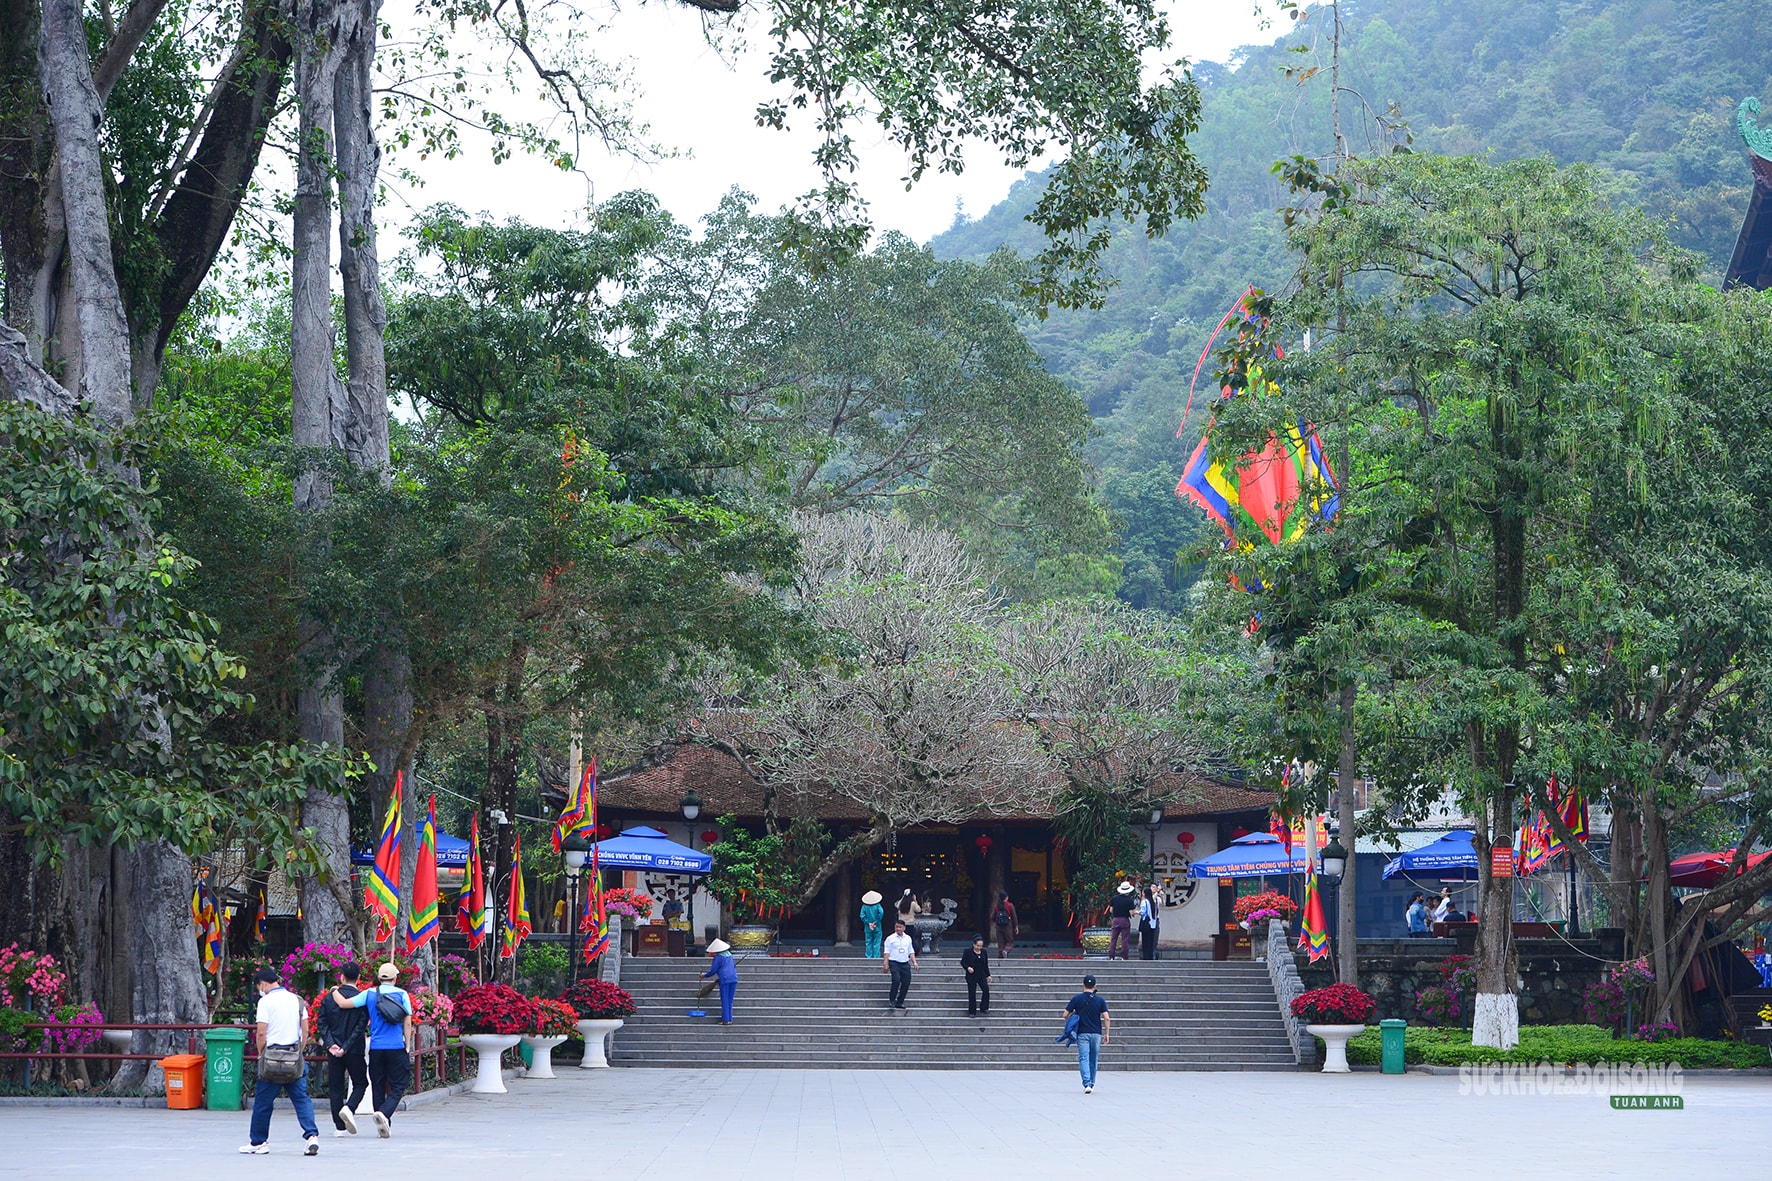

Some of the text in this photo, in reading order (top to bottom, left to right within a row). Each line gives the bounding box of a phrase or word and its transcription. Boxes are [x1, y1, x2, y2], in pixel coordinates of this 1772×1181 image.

[597, 851, 615, 859] CHỦNG
[615, 852, 629, 860] VNVC
[1206, 865, 1227, 873] TRUNG
[1255, 861, 1277, 869] CHỦNG
